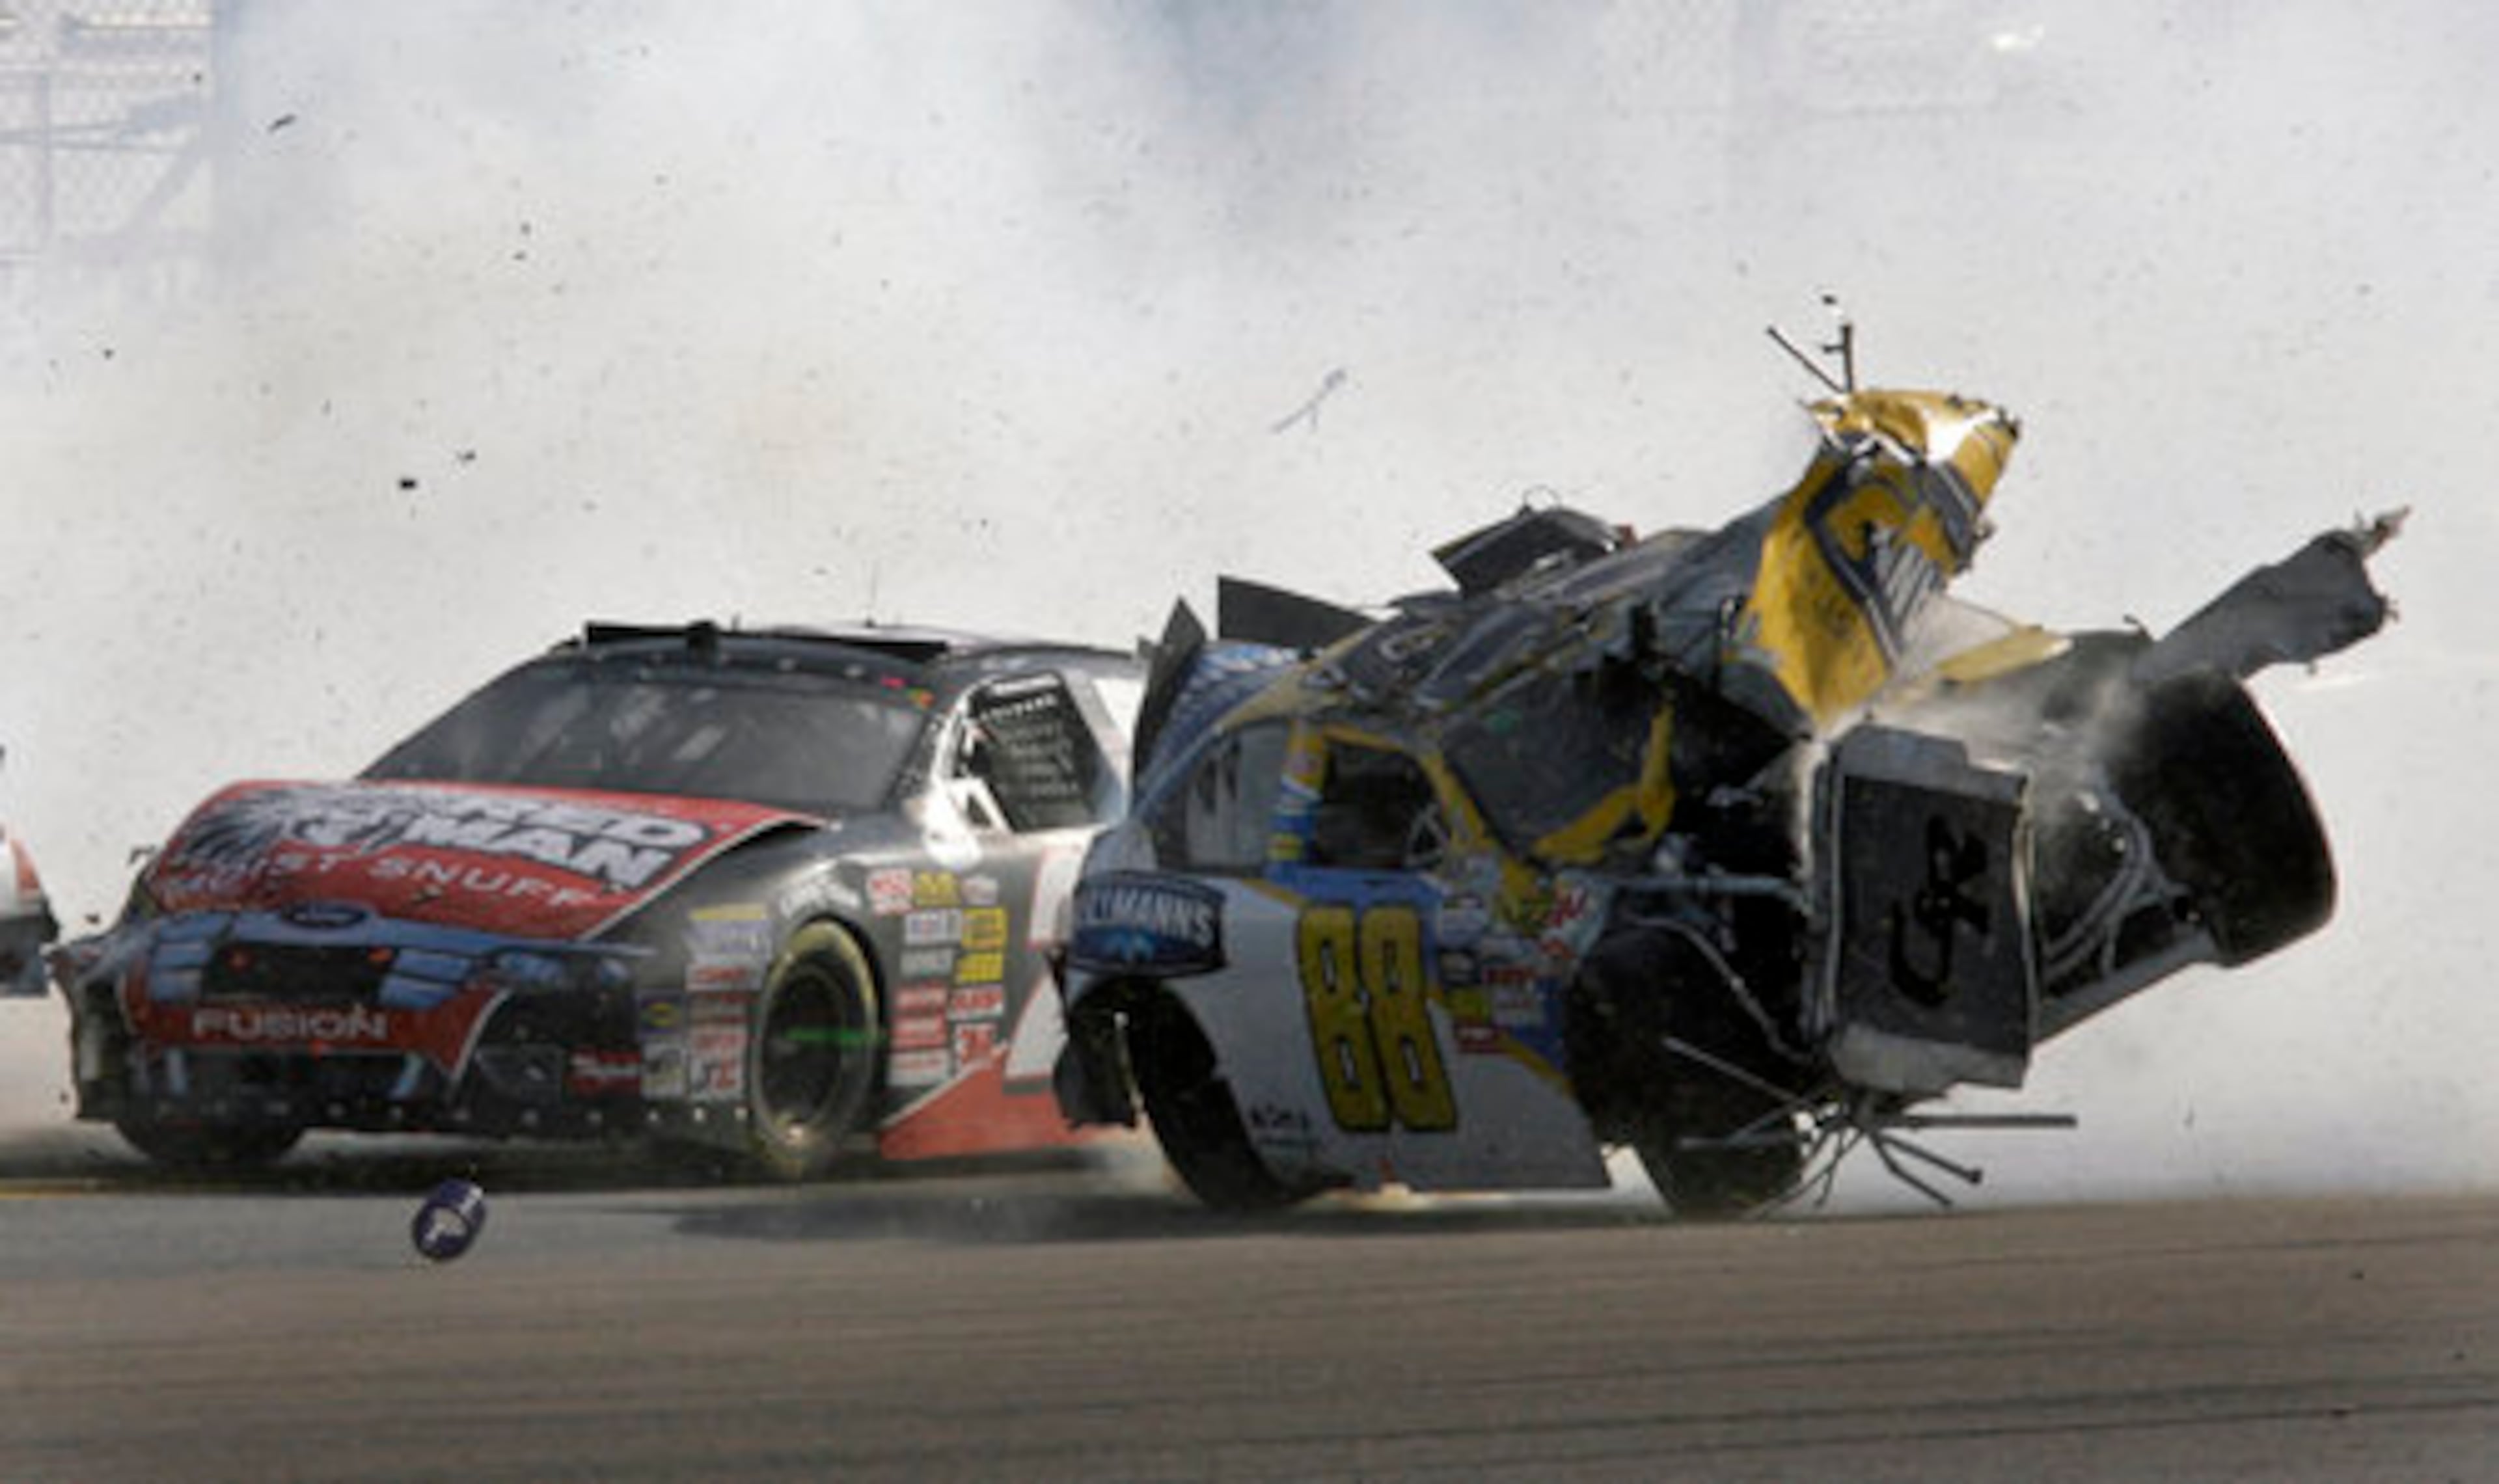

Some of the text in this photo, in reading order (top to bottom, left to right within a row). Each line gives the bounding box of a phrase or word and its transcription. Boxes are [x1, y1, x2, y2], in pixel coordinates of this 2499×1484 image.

[367, 852, 595, 908] SNUFF
[399, 812, 675, 889] MAN
[193, 1005, 387, 1042] FUSION
[1295, 901, 1458, 1133] 88
